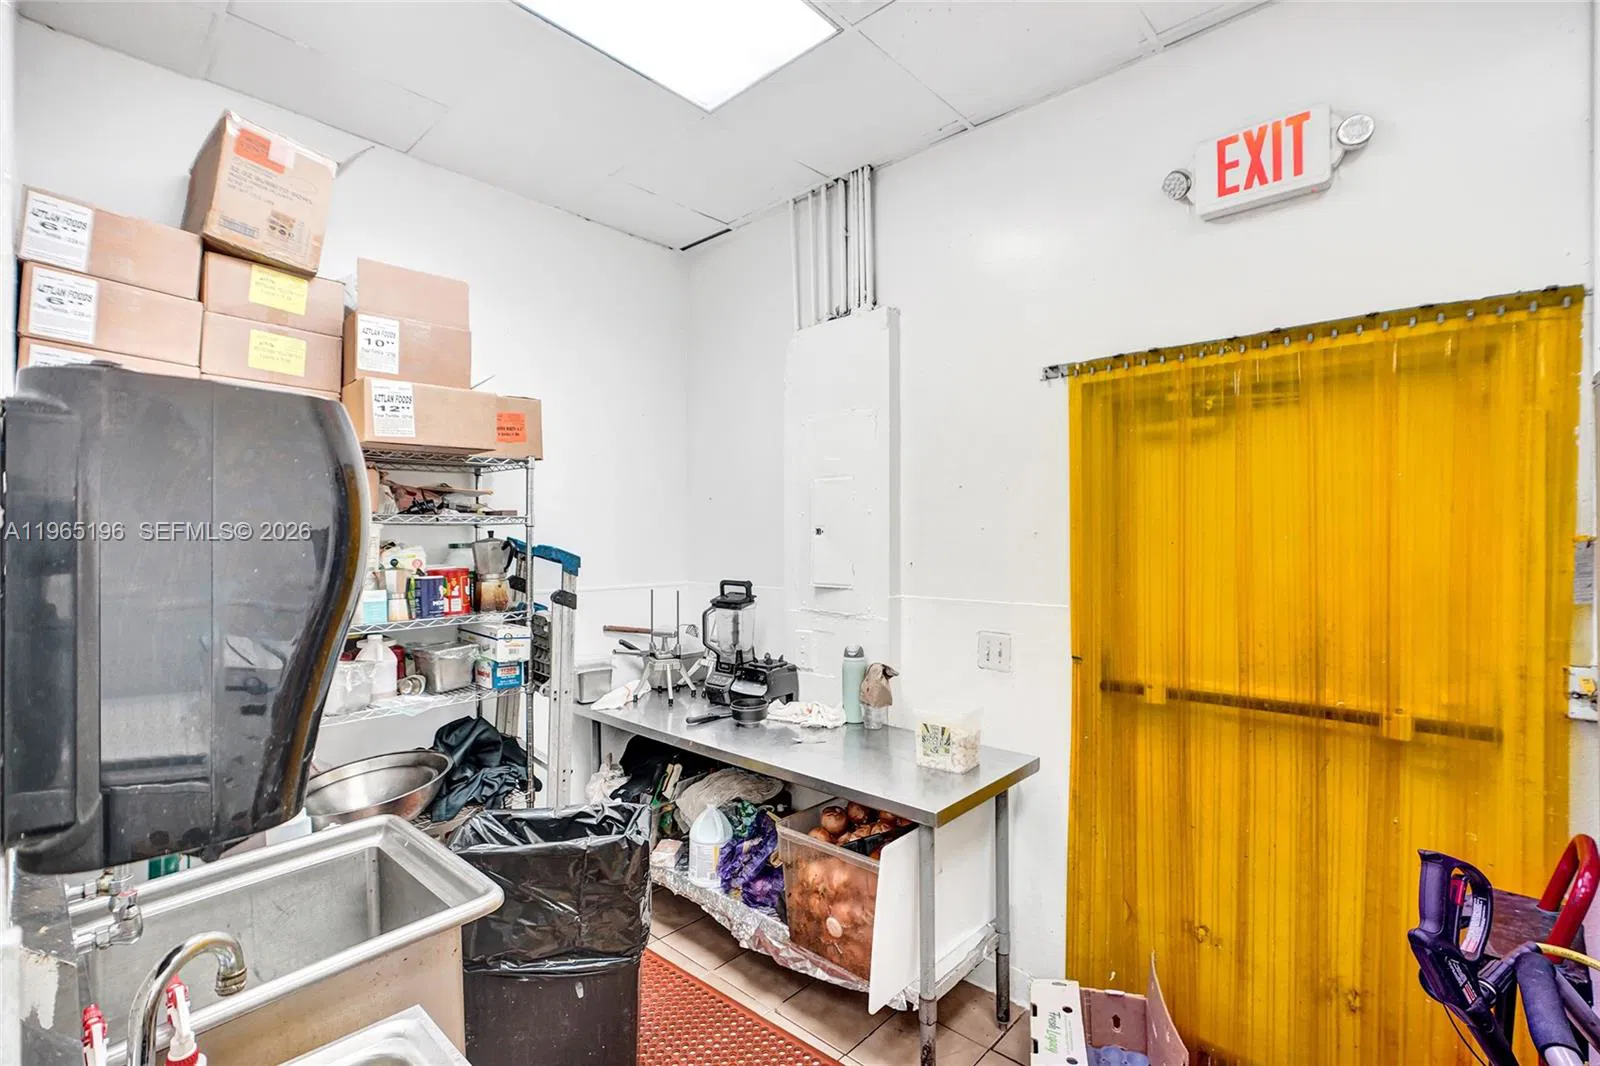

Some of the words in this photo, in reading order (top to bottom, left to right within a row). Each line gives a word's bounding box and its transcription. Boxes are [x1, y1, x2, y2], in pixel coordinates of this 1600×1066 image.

[1217, 111, 1311, 198] EXIT
[63, 216, 87, 230] FOODS
[68, 289, 93, 302] FOODS
[362, 327, 379, 336] AZTLAN
[381, 329, 395, 338] FOODS
[374, 393, 393, 403] AZTLAN
[395, 395, 412, 404] FOODS
[1048, 1012, 1061, 1030] Fresh
